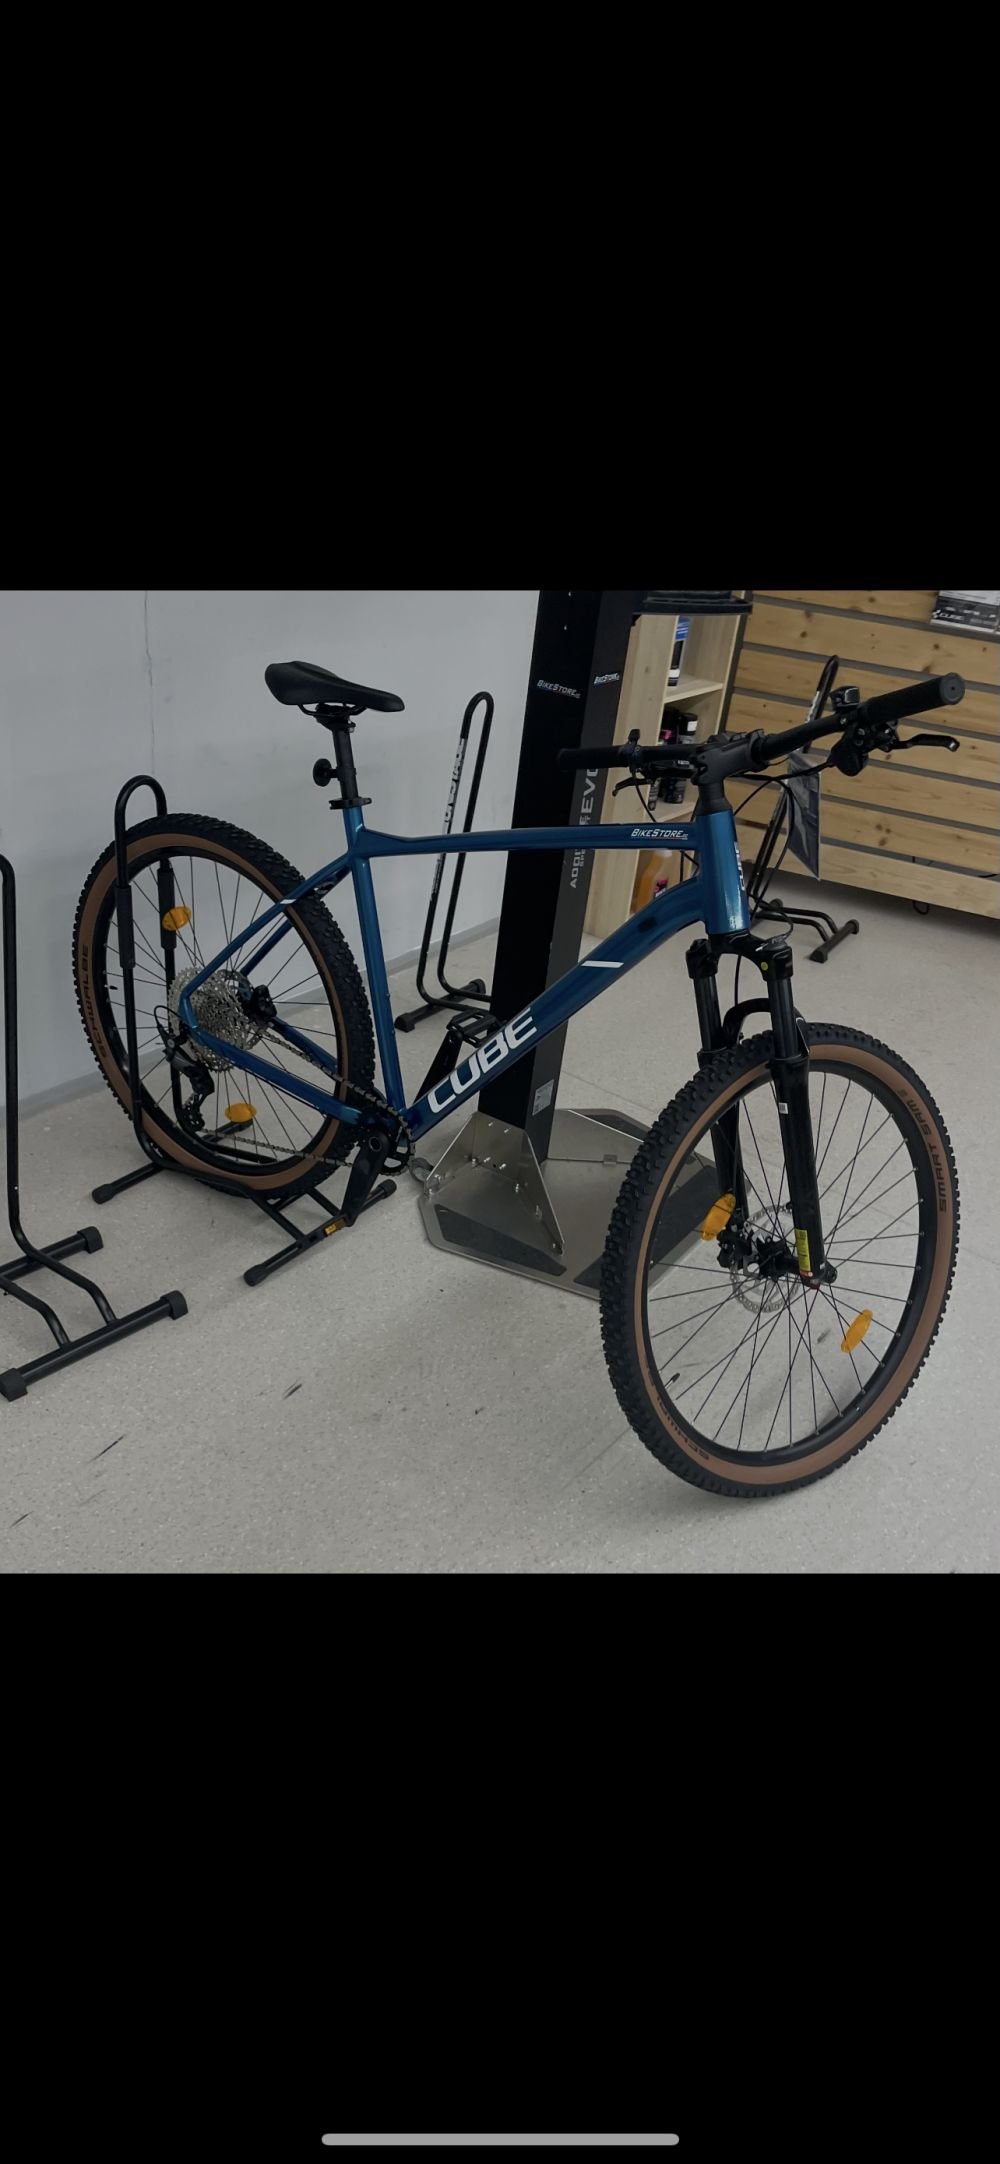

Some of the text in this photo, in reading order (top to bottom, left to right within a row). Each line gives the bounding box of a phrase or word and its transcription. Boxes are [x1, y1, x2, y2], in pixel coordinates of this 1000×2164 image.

[569, 848, 583, 889] ADDI
[80, 943, 108, 1059] SCHWALBE
[426, 1006, 538, 1114] CUBE
[906, 1099, 947, 1213] SMART SAM
